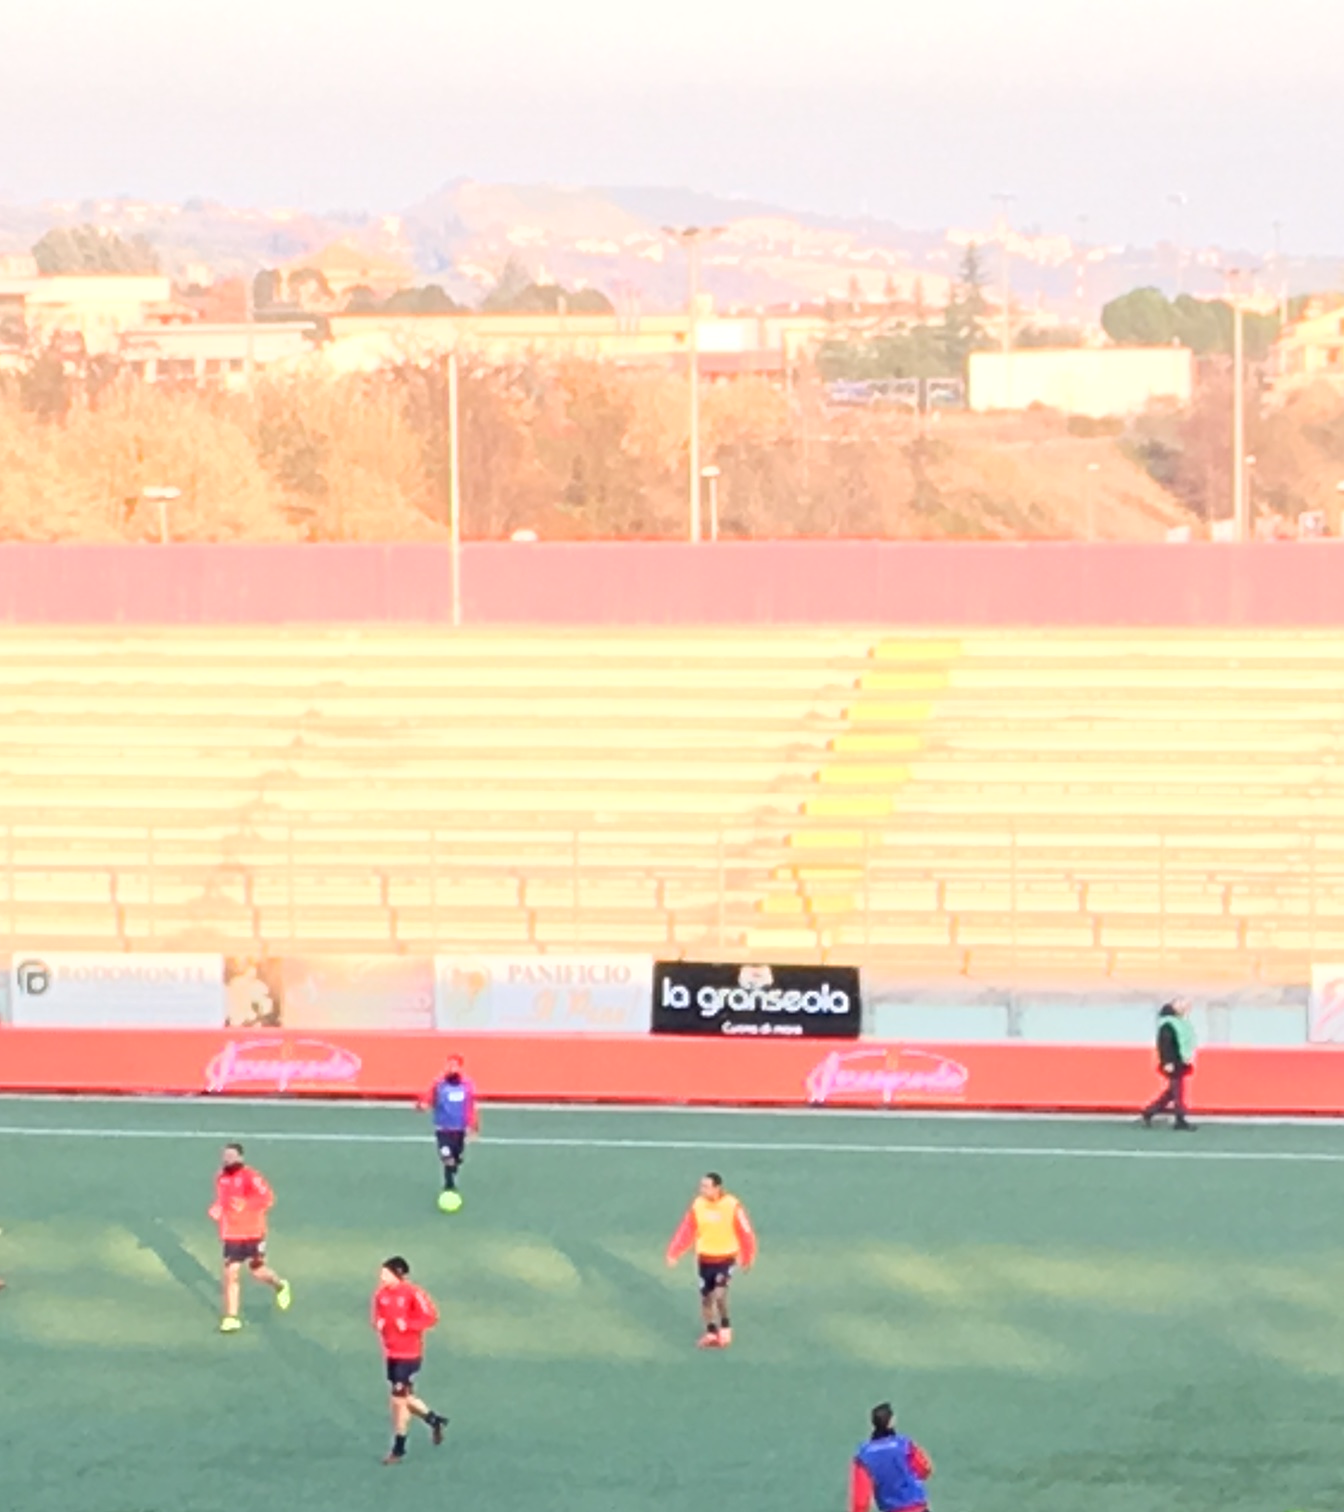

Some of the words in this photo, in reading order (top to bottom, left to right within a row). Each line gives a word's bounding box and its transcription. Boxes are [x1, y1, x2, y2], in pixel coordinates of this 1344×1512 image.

[507, 964, 632, 985] PANIFICIO
[661, 977, 691, 1010] la
[696, 982, 851, 1019] granseola
